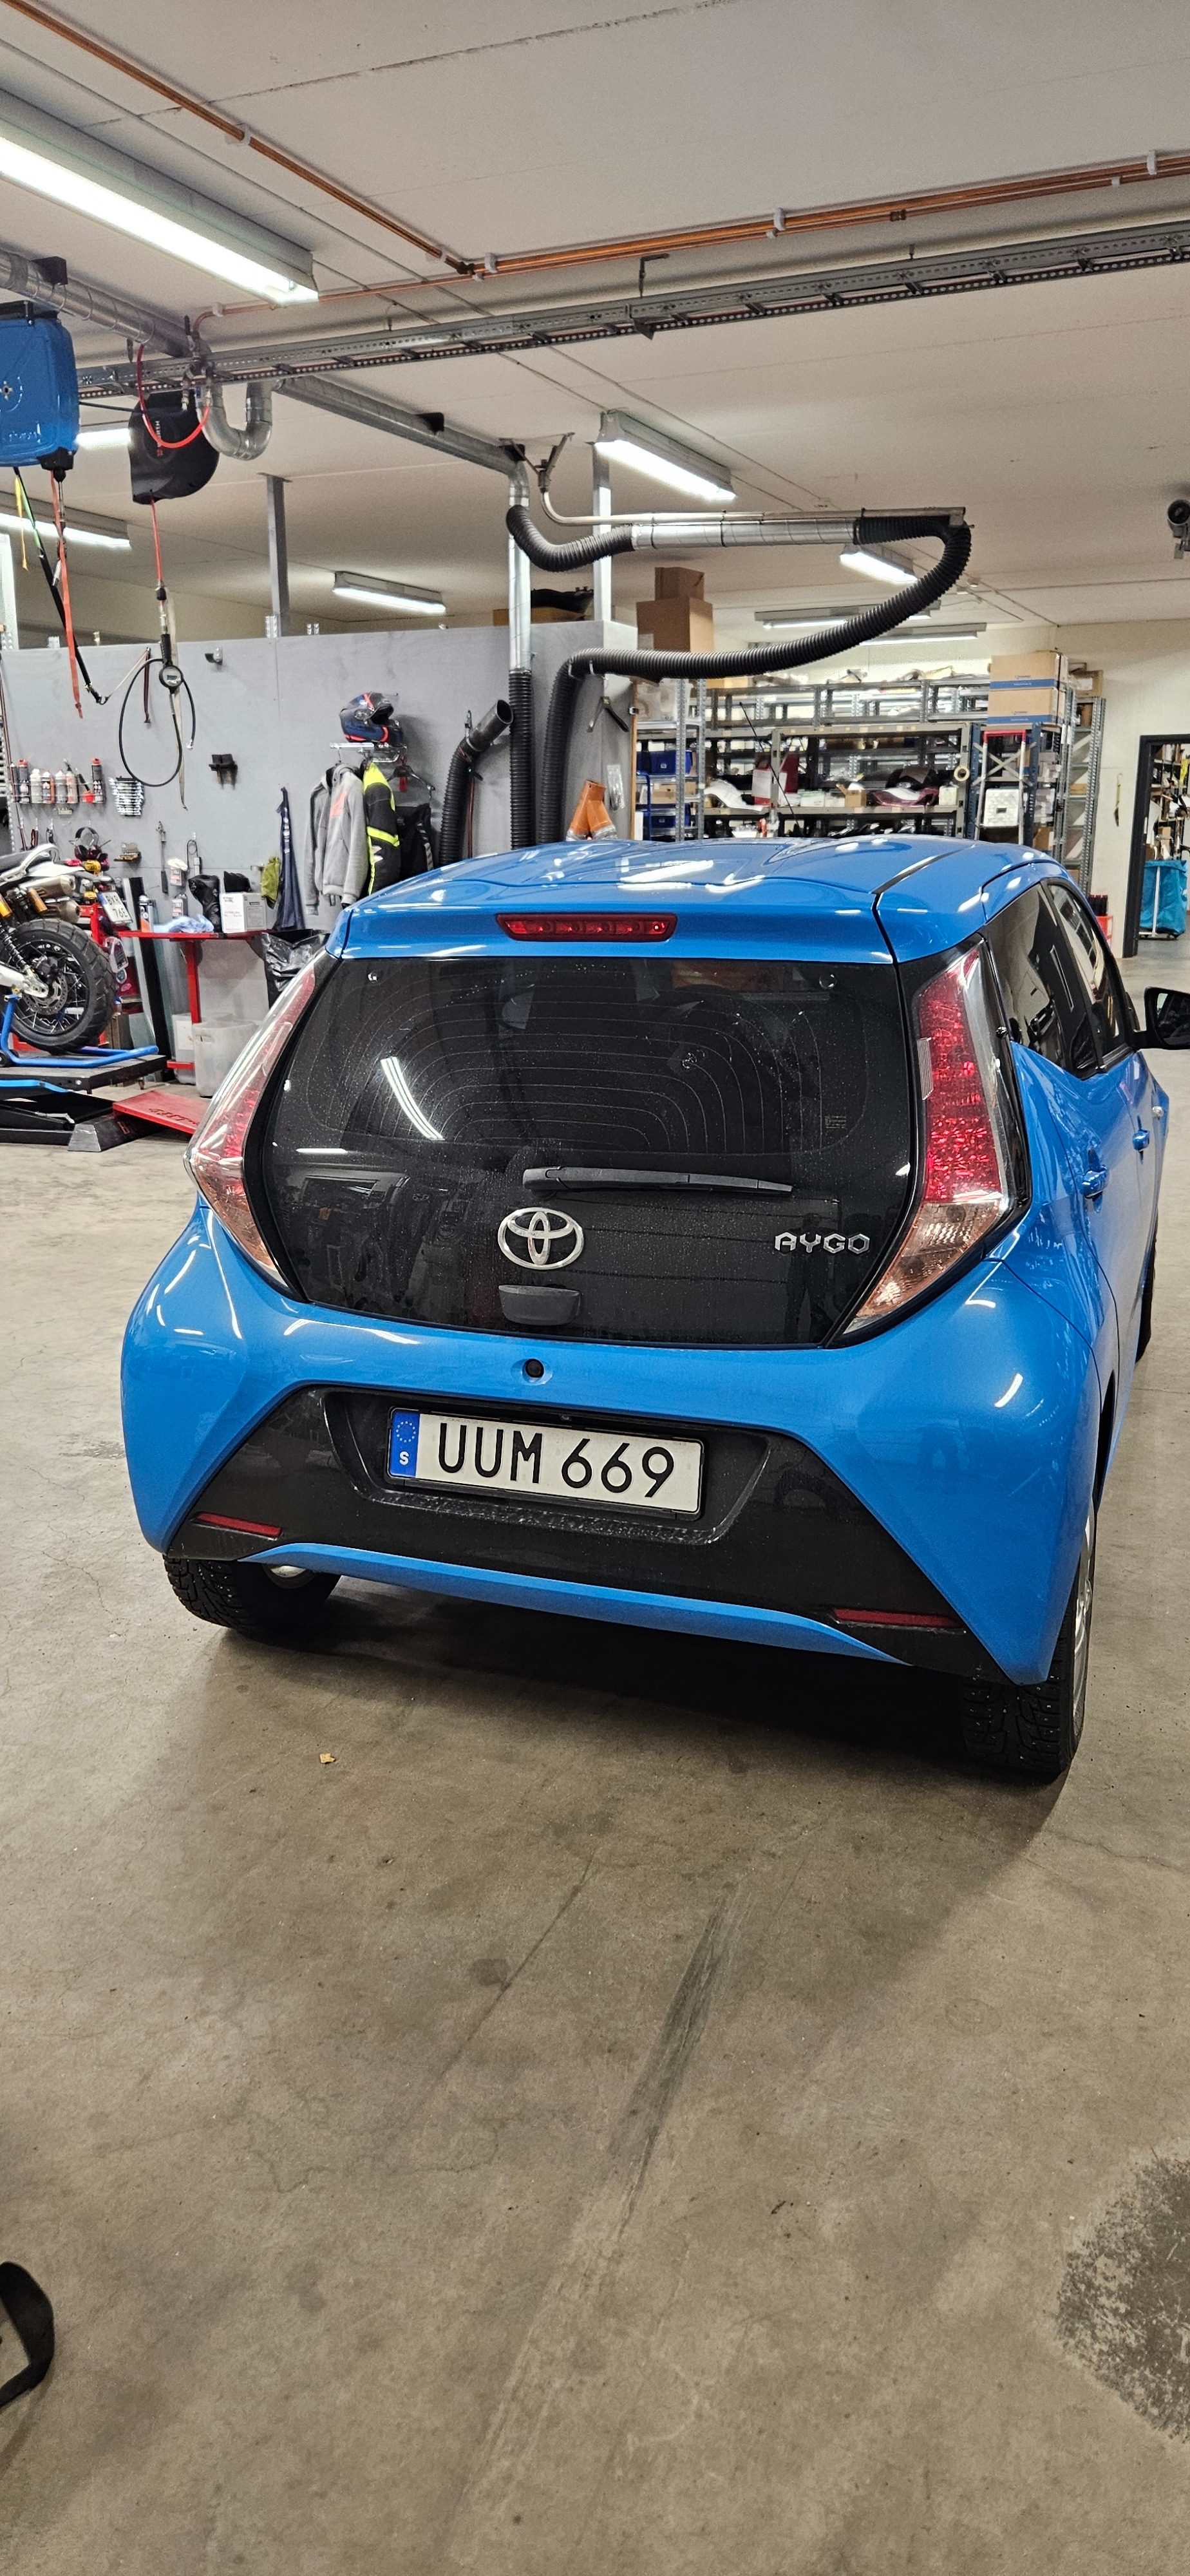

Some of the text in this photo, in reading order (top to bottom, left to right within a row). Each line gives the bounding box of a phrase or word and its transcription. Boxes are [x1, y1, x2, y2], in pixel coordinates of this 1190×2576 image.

[774, 1231, 871, 1255] AYGO
[399, 1451, 410, 1466] S
[438, 1422, 675, 1498] UUM 669
